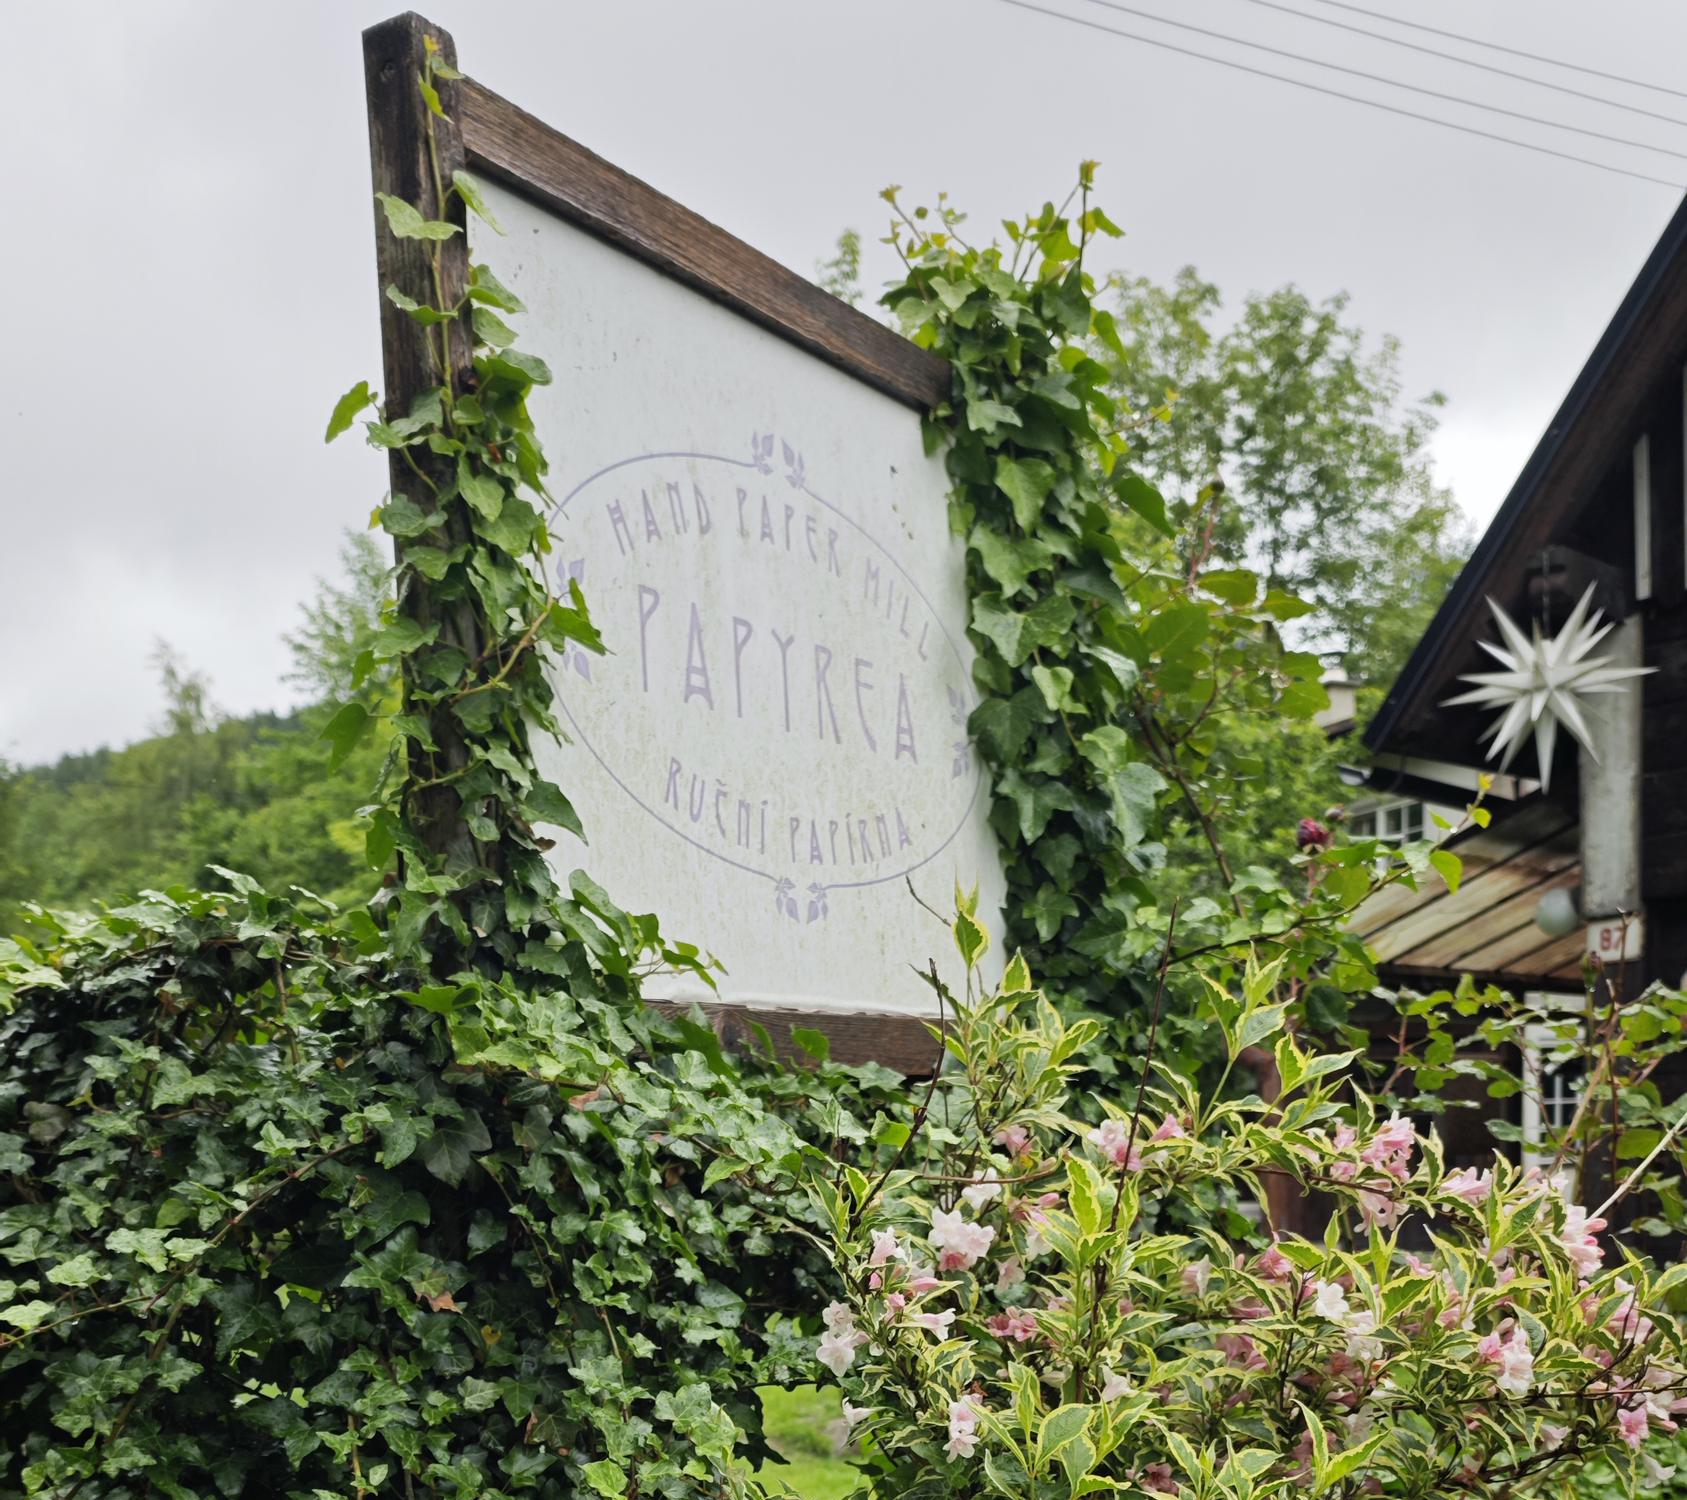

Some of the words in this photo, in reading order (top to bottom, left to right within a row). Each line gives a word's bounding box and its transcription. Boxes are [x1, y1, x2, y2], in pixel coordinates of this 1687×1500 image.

[606, 481, 711, 556] HAND
[736, 487, 840, 577] PAPER
[864, 557, 928, 662] MILL
[637, 583, 918, 765] PAPYREA
[789, 806, 913, 866] PAPÍRNA
